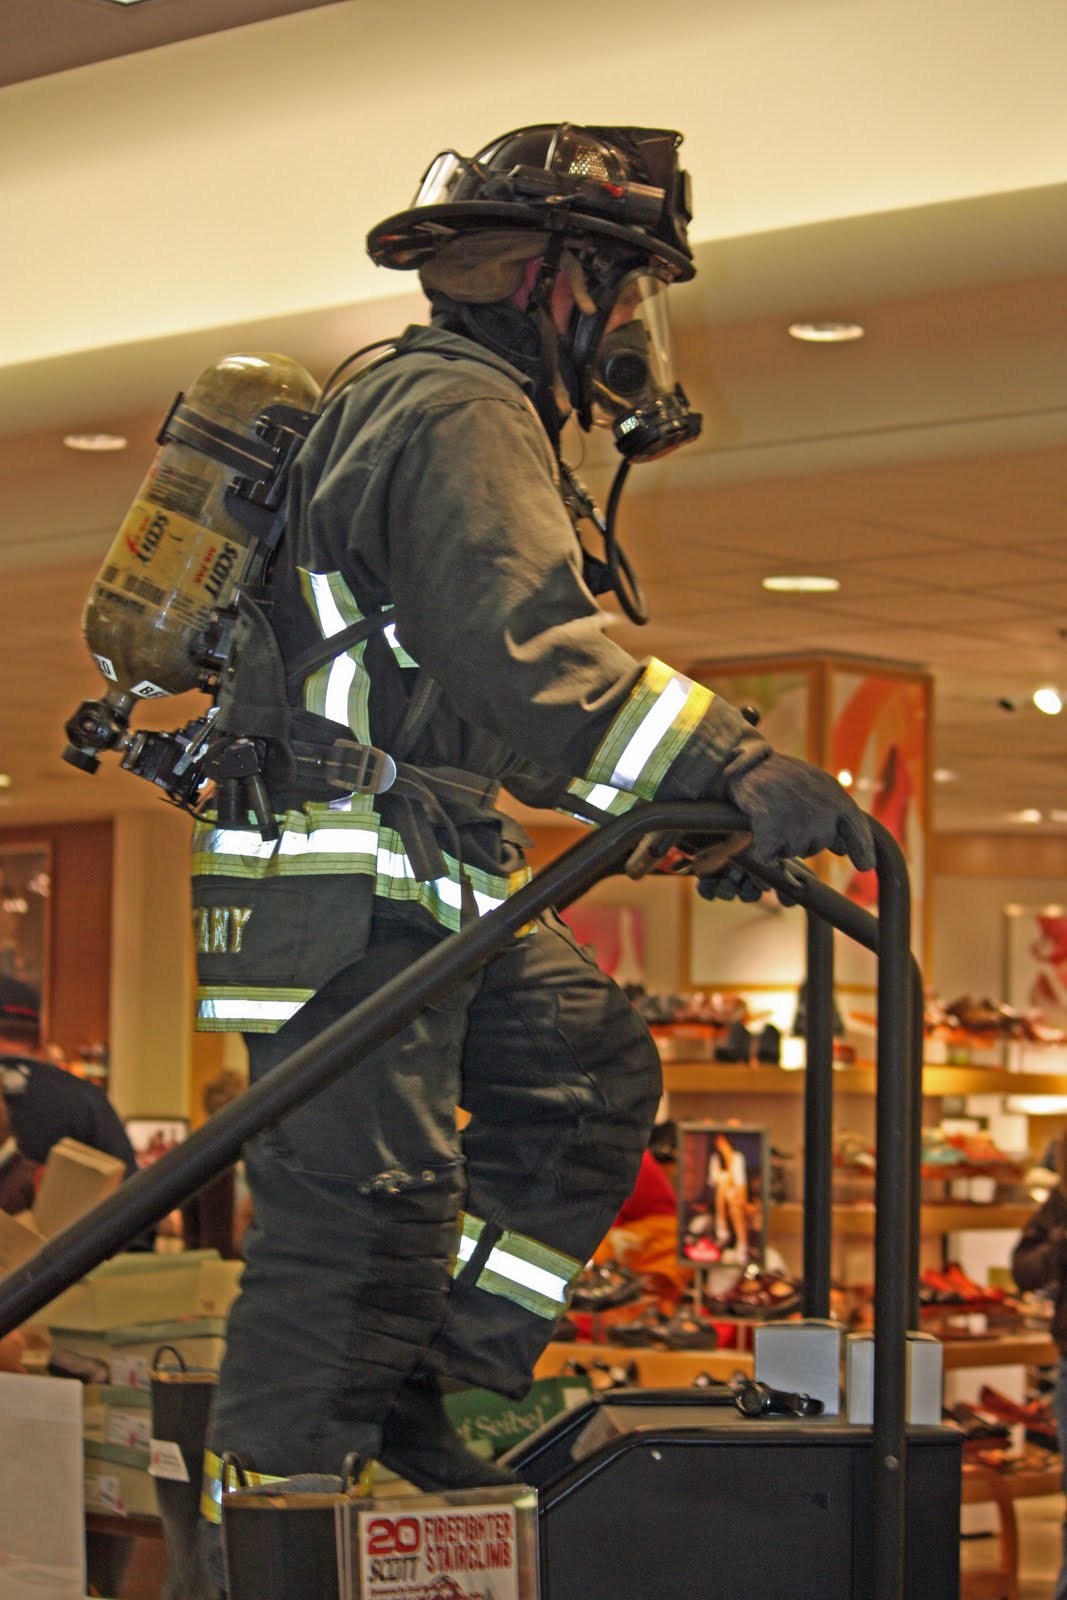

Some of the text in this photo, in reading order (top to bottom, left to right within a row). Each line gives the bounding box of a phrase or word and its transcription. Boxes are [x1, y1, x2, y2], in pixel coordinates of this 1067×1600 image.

[204, 541, 238, 601] SCOTT
[367, 1518, 418, 1555] 20
[424, 1514, 512, 1542] FIREFIGHTER
[368, 1557, 418, 1584] SCOTT
[425, 1542, 511, 1573] STAIRCLIMB
